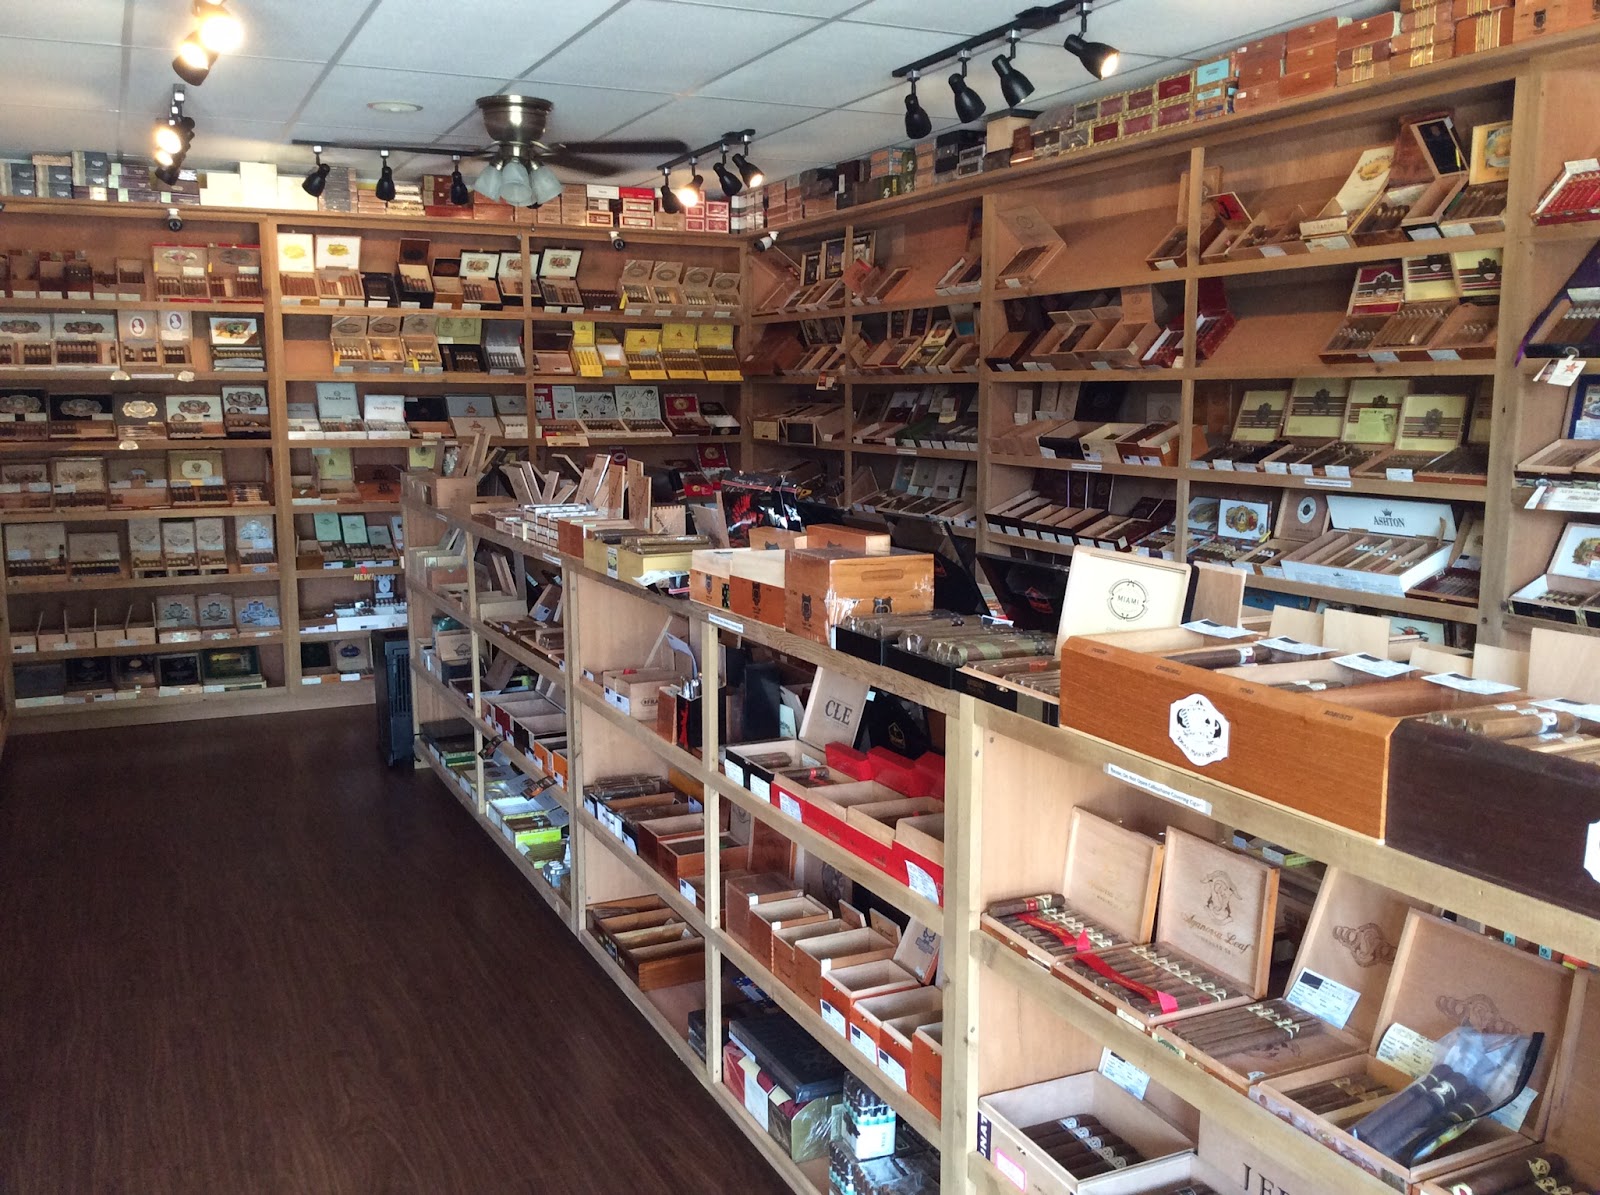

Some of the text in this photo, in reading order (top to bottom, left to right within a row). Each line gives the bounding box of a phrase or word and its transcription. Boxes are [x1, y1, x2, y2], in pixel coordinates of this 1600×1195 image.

[1373, 516, 1405, 528] ASHTON
[353, 573, 375, 581] NEW!
[1117, 595, 1140, 605] MIAMI
[825, 699, 853, 726] CLE
[1323, 709, 1354, 721] ROBUSTO
[1224, 932, 1252, 954] Leaf
